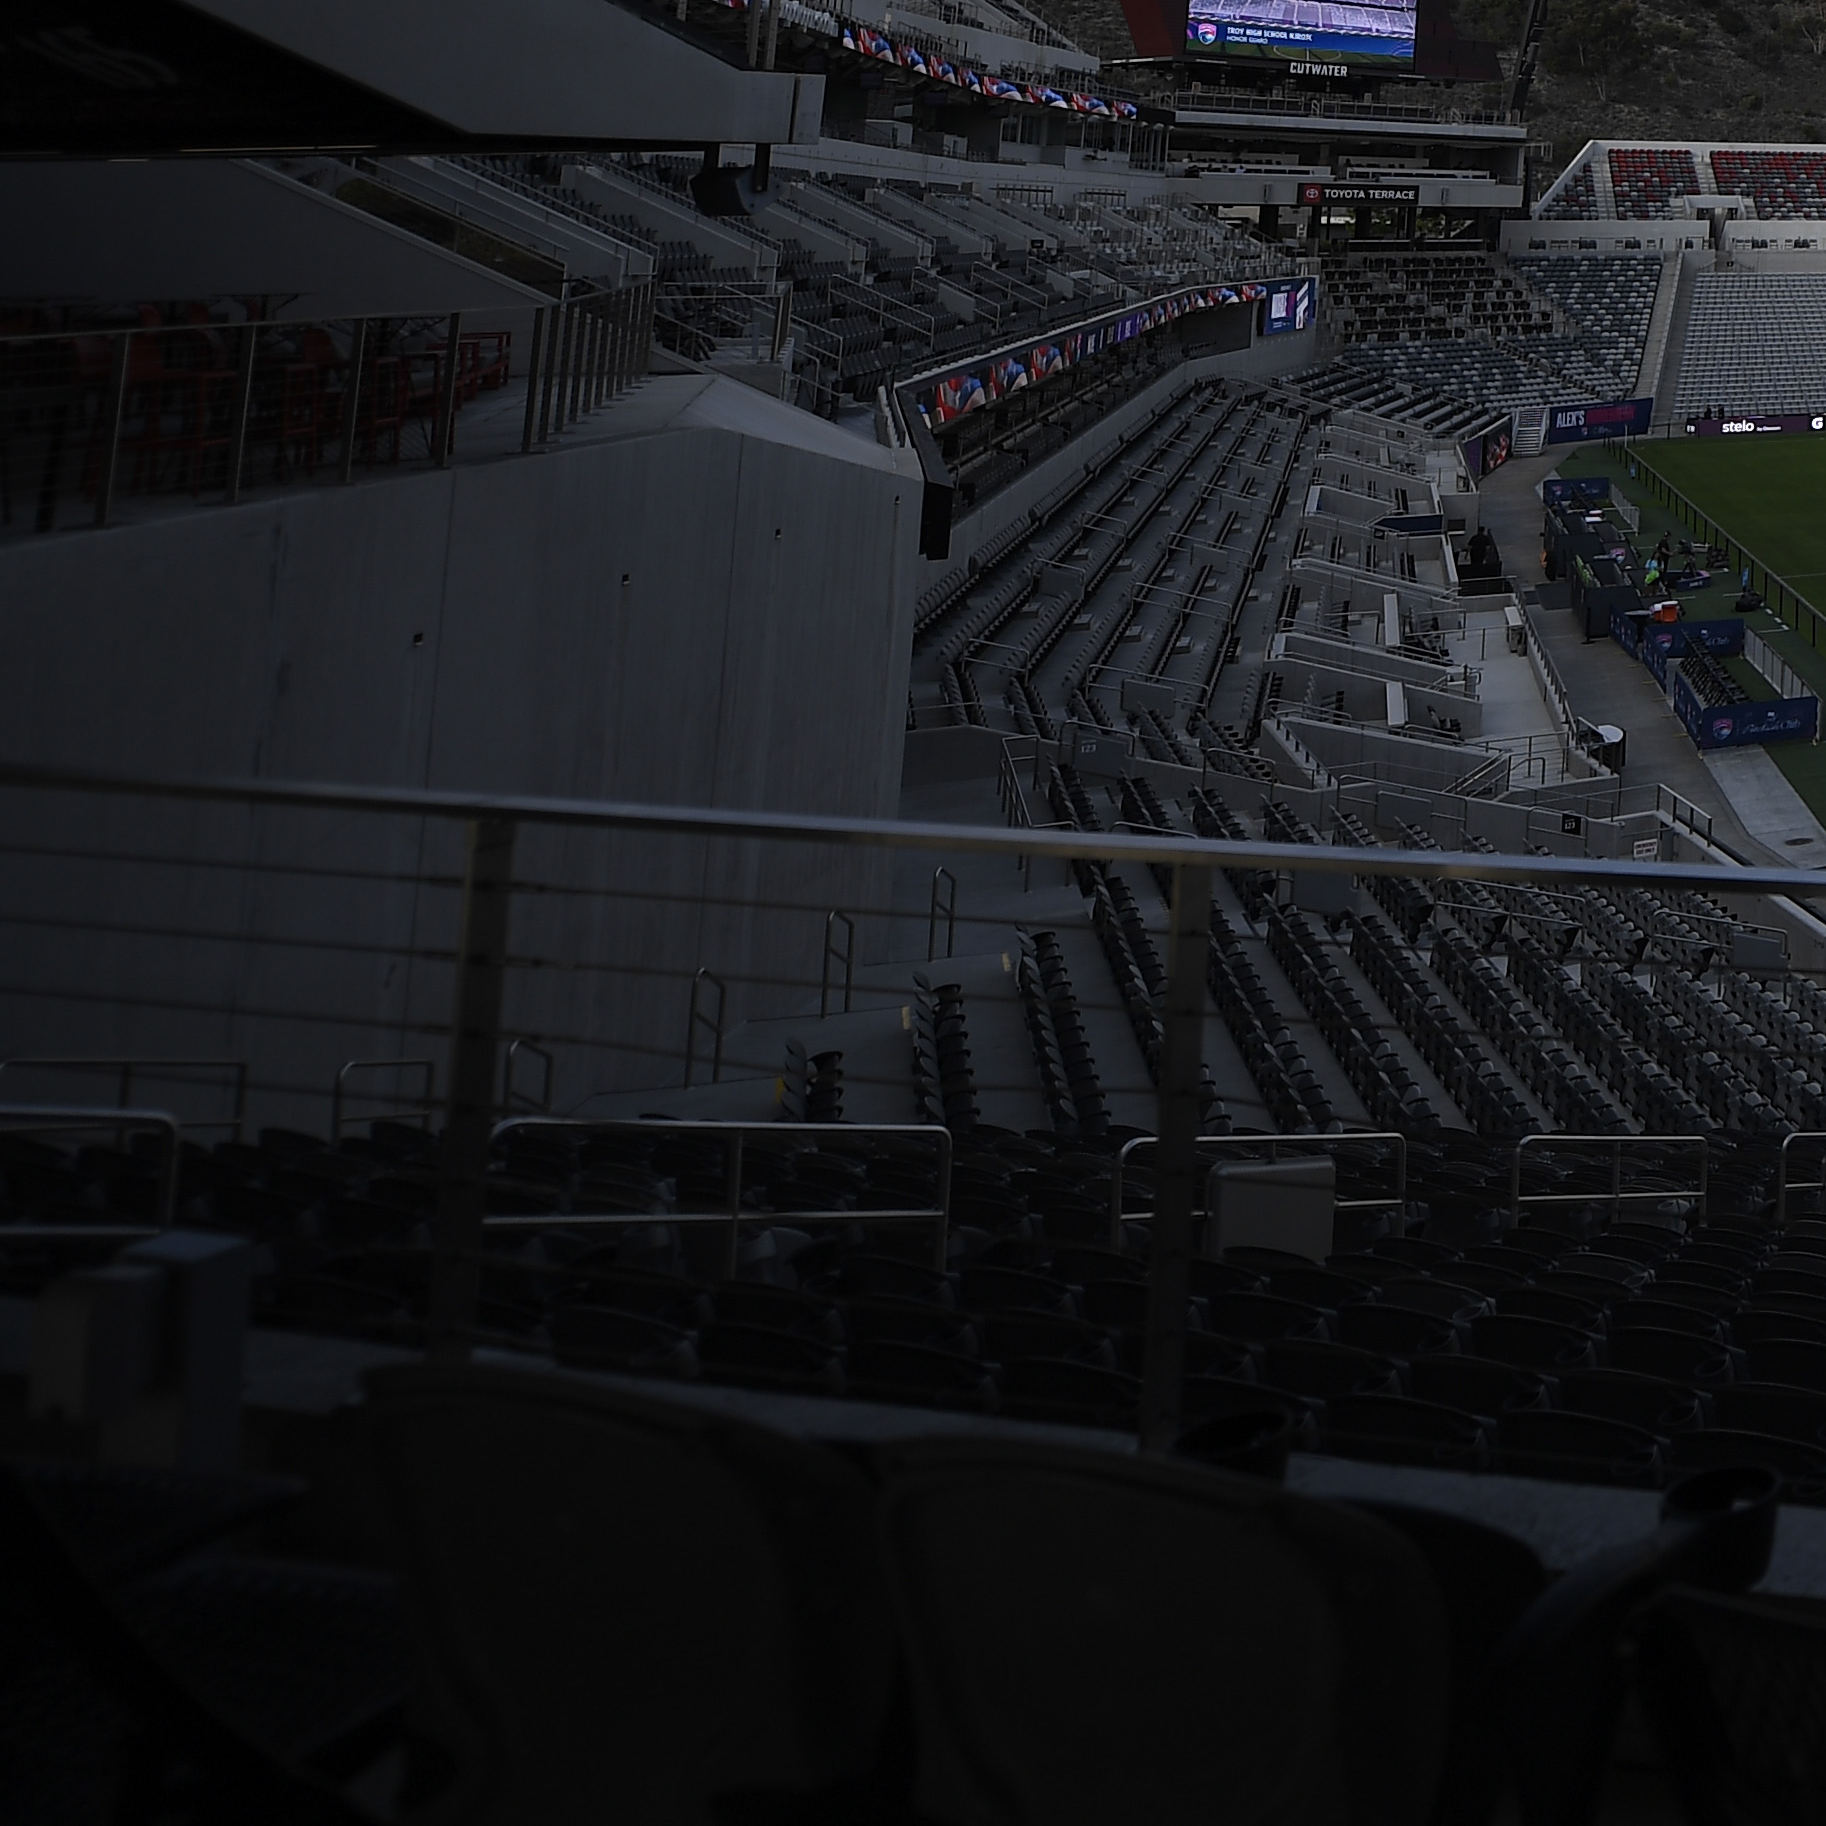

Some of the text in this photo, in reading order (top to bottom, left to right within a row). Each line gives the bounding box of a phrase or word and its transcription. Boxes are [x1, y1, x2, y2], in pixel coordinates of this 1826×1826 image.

[1289, 62, 1348, 78] CUTWATER
[1324, 189, 1416, 200] TOYOTA TERRACE
[1555, 410, 1586, 429] ALEX'S
[1722, 419, 1755, 432] stelo
